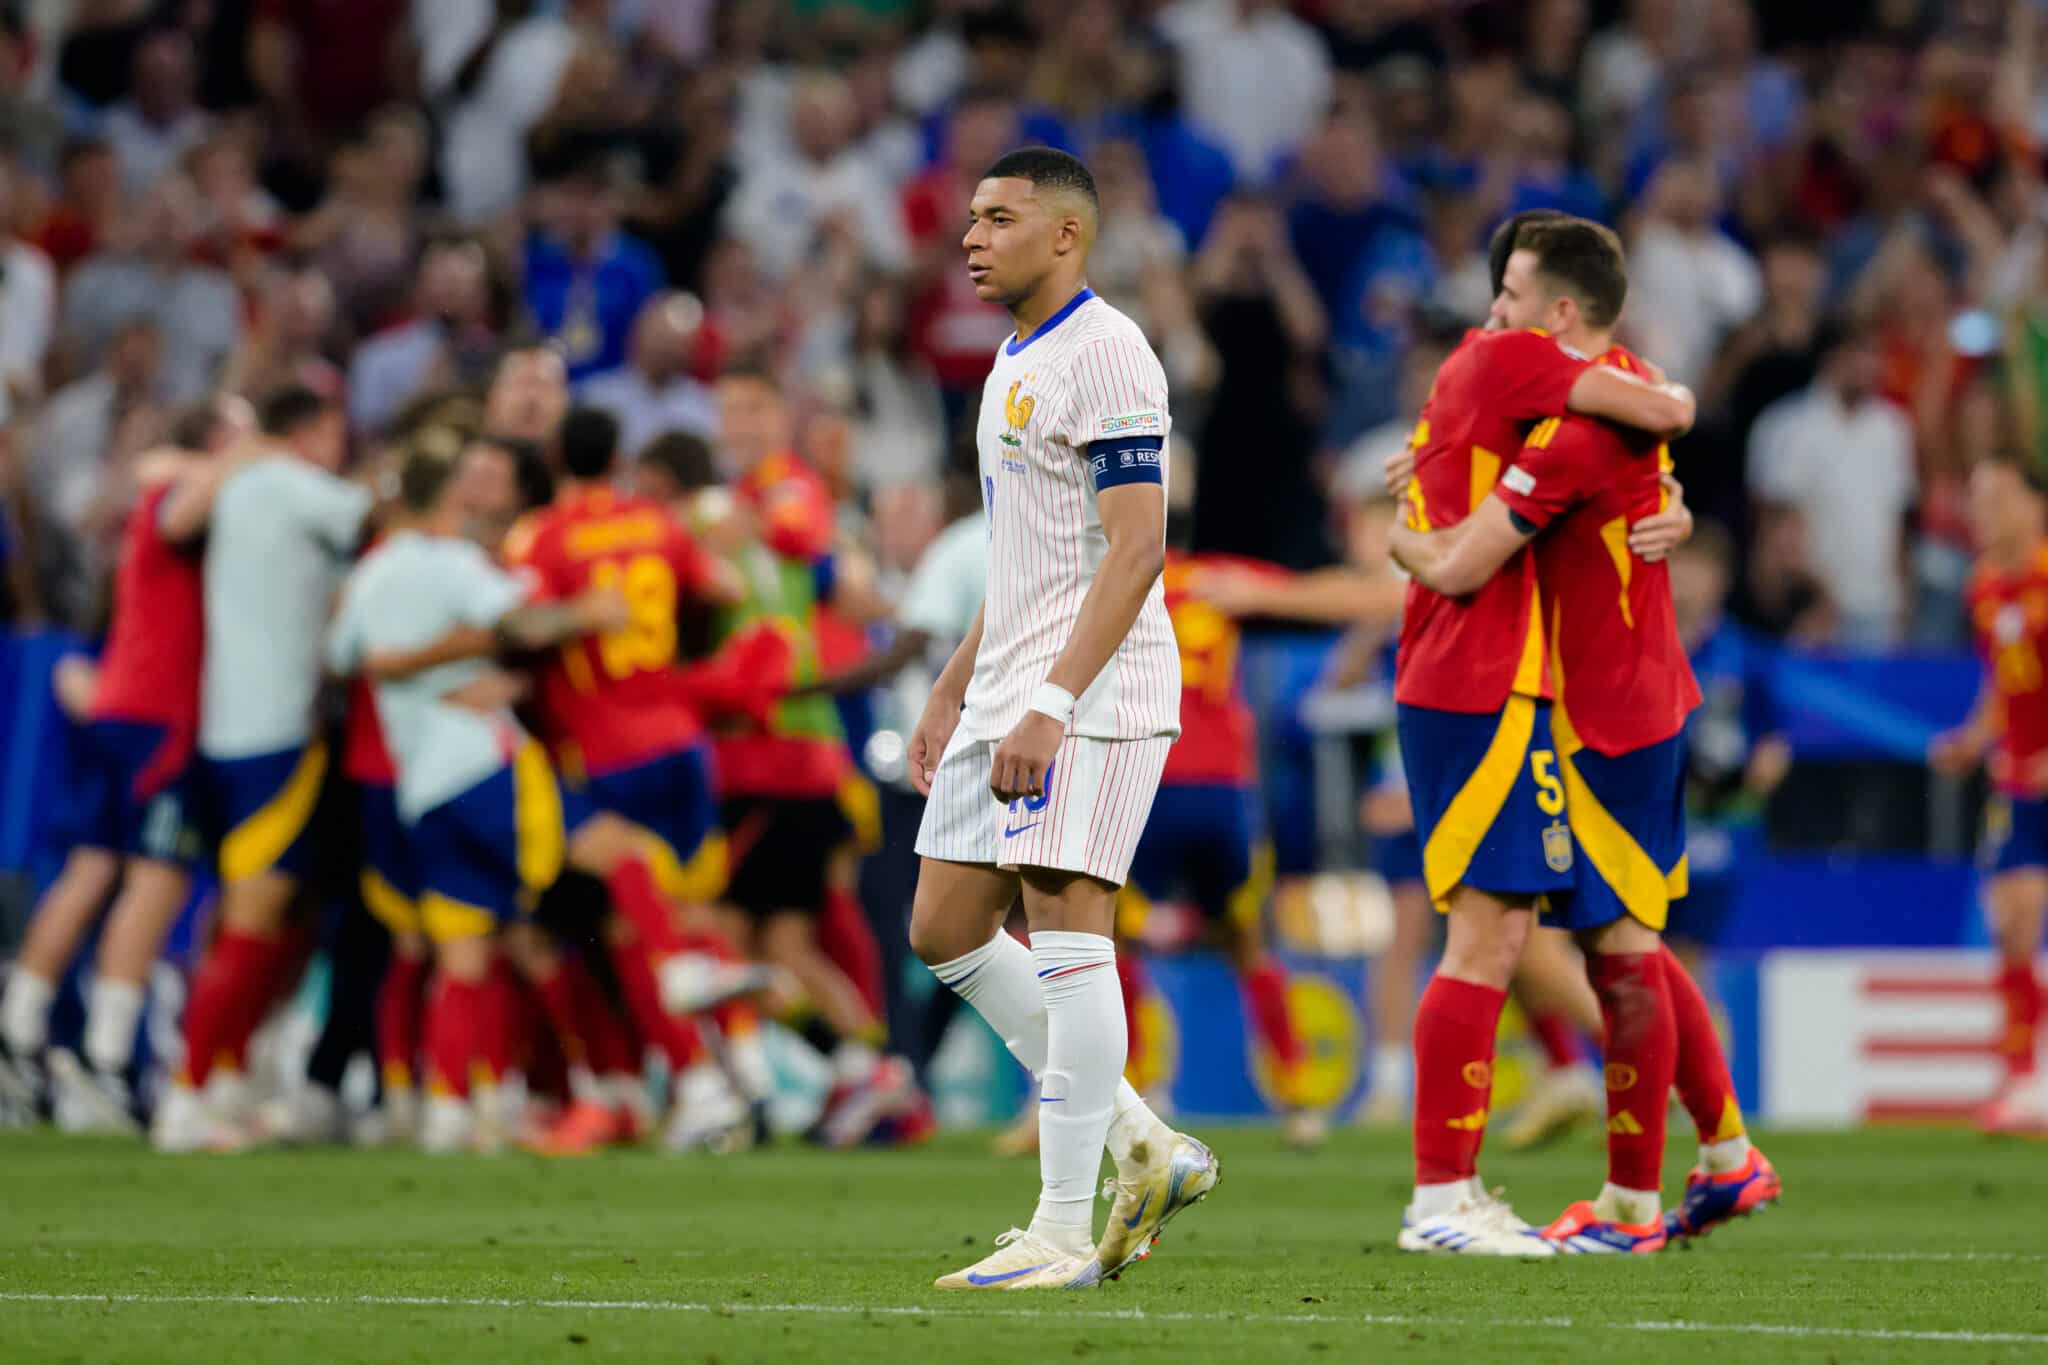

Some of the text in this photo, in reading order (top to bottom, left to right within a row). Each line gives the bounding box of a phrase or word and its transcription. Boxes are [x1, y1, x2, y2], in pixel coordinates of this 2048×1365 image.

[1101, 415, 1158, 431] FOUNDATION
[1137, 451, 1160, 463] RES
[1530, 749, 1565, 816] 5
